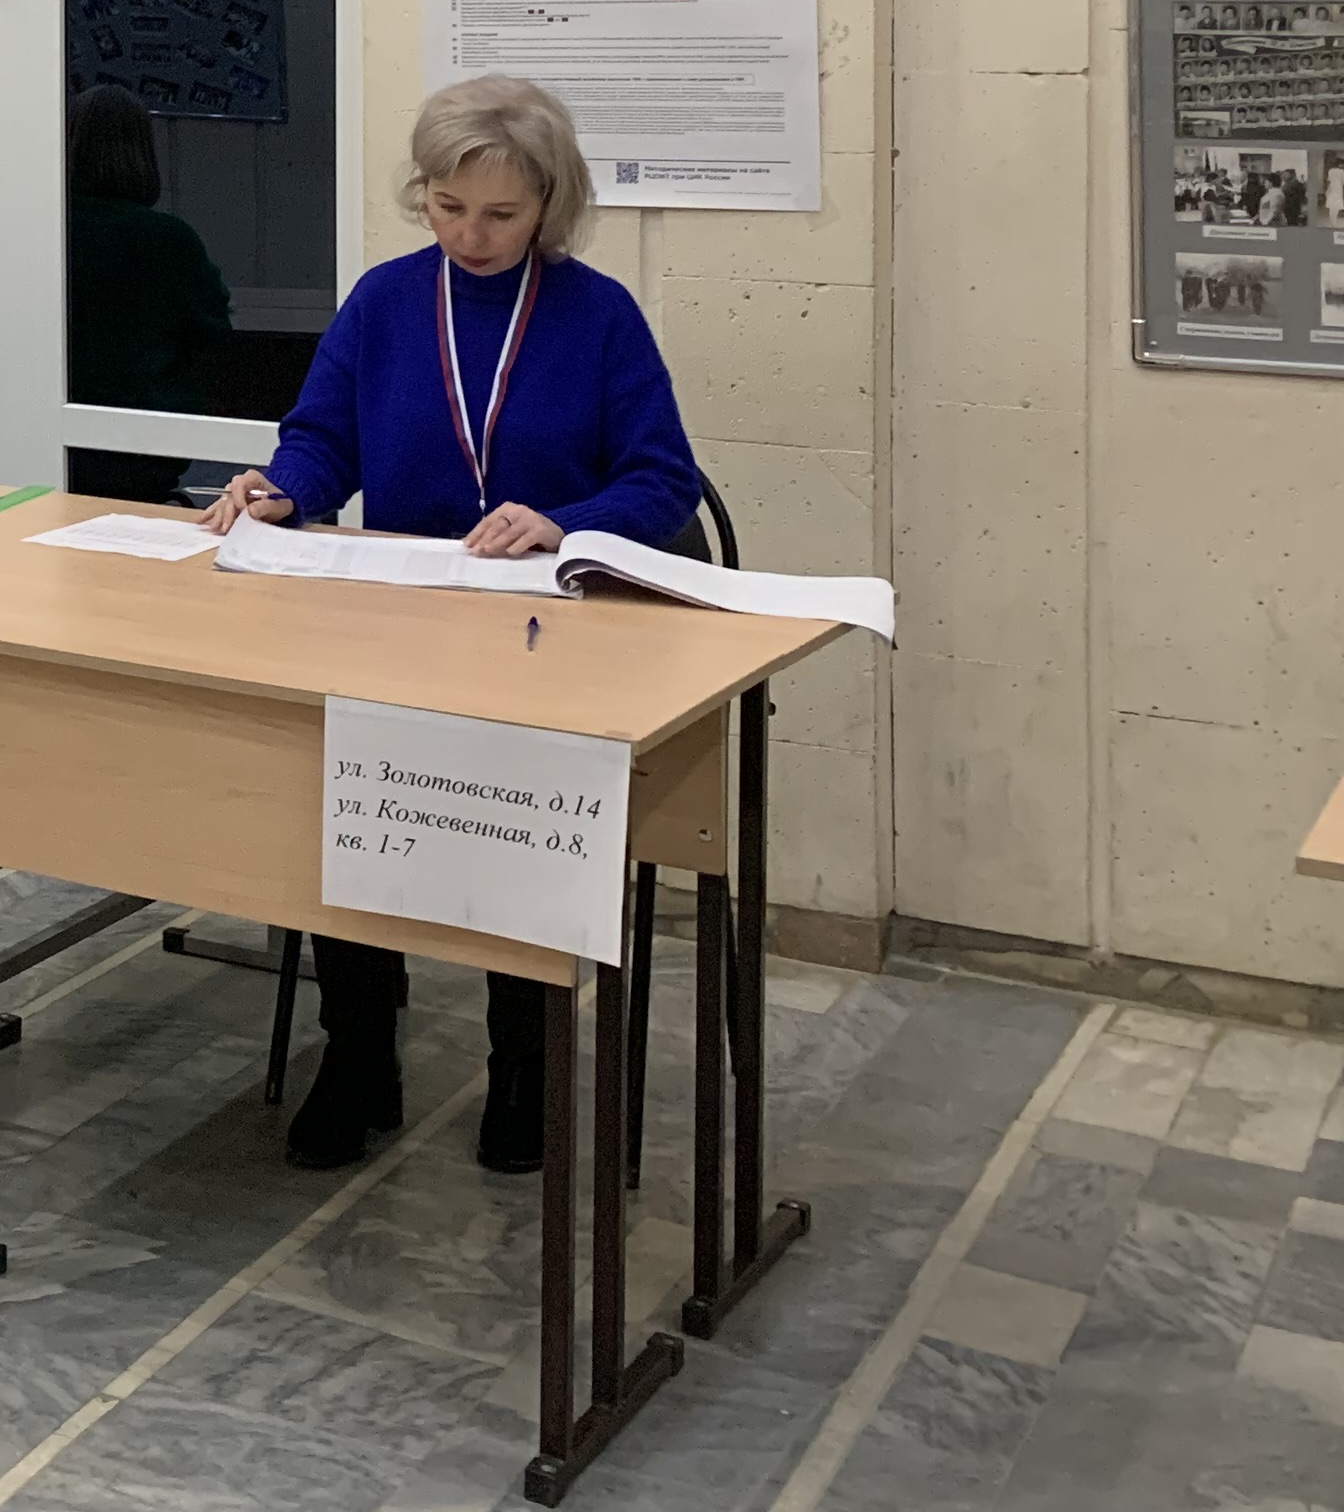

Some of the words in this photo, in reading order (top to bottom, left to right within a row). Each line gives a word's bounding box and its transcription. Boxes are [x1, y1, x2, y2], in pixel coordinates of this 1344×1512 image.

[334, 760, 367, 780] ул.
[376, 761, 540, 811] Золотовская,
[549, 790, 602, 820] д.14
[334, 798, 367, 818] ул.
[376, 799, 537, 850] Кожевенная,
[546, 829, 589, 860] д.8,
[336, 833, 367, 852] кв.
[378, 834, 416, 858] 1-7
